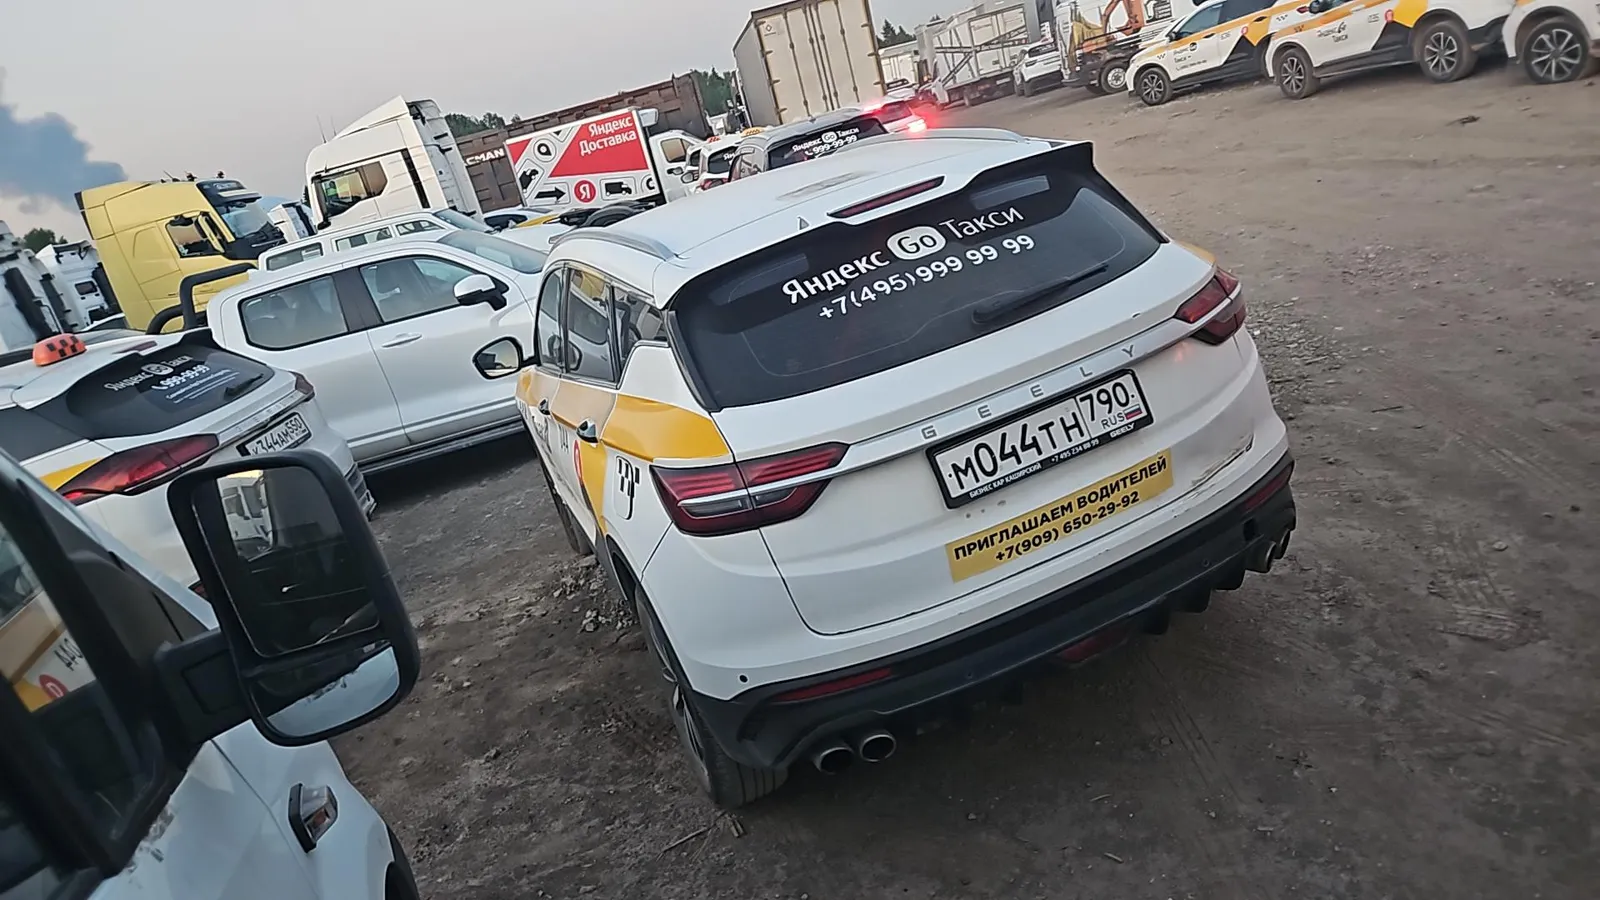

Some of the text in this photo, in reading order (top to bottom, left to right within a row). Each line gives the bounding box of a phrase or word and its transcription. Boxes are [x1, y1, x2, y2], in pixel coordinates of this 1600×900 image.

[588, 116, 633, 137] Яндекс
[792, 138, 822, 152] Яндекс
[836, 127, 859, 137] Такси
[466, 148, 505, 165] CMAN
[579, 130, 637, 157] Доставка
[812, 134, 858, 154] 999-99-99
[579, 183, 591, 199] Я
[782, 250, 890, 304] Яндекс
[939, 206, 1025, 239] Такси
[819, 234, 1035, 319] +7(495)999 99 99
[159, 364, 210, 387] 999-99-99
[921, 344, 1136, 440] GEELY
[1101, 412, 1125, 430] RUS
[1109, 423, 1136, 438] GEELY
[950, 381, 1130, 490] М044ТН 790
[969, 484, 993, 499] БИЗНЕС
[993, 479, 1005, 489] КАР
[1005, 463, 1042, 483] КАШИРСКИЙ
[1060, 450, 1071, 461] 495
[953, 456, 1168, 560] ПРИГЛАШАЕМ ВОДИТЕЛЕЙ
[995, 491, 1140, 562] +7(909) 650-29-92
